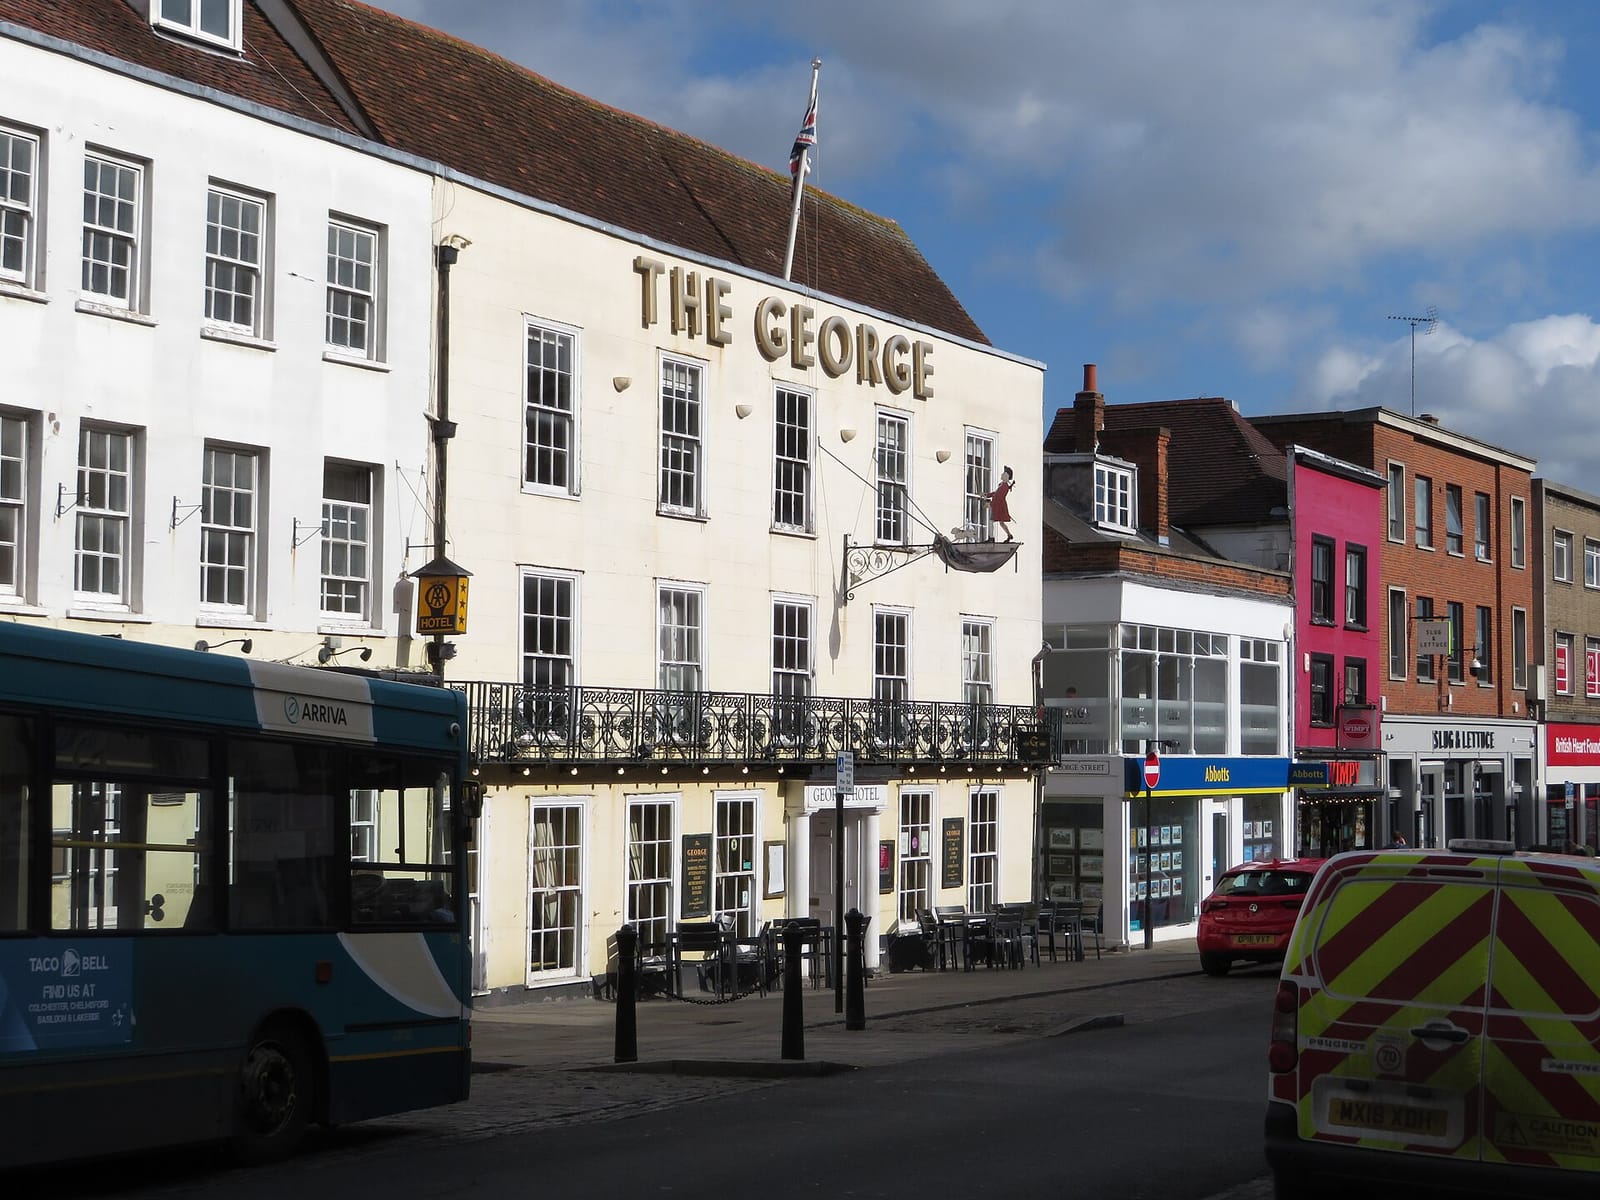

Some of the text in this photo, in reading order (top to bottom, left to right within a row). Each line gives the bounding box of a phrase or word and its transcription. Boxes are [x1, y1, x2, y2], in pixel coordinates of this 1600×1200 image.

[633, 255, 934, 401] THE GEORGE
[421, 617, 453, 629] HOTEL
[302, 702, 347, 726] ARRIVA
[1433, 730, 1495, 749] SLUG & LETTUCE
[1555, 736, 1572, 753] British
[1572, 737, 1587, 754] Heart
[1205, 765, 1231, 782] Abbotts
[1292, 770, 1325, 779] Abbotts
[852, 787, 880, 801] HOTEL
[687, 848, 708, 857] GEORGE
[28, 955, 109, 972] TACO BELL
[43, 983, 96, 999] FIND US AT
[1308, 1038, 1367, 1051] PEUGEOT
[1340, 1101, 1385, 1124] MX18
[1528, 1119, 1598, 1137] CAUTION
